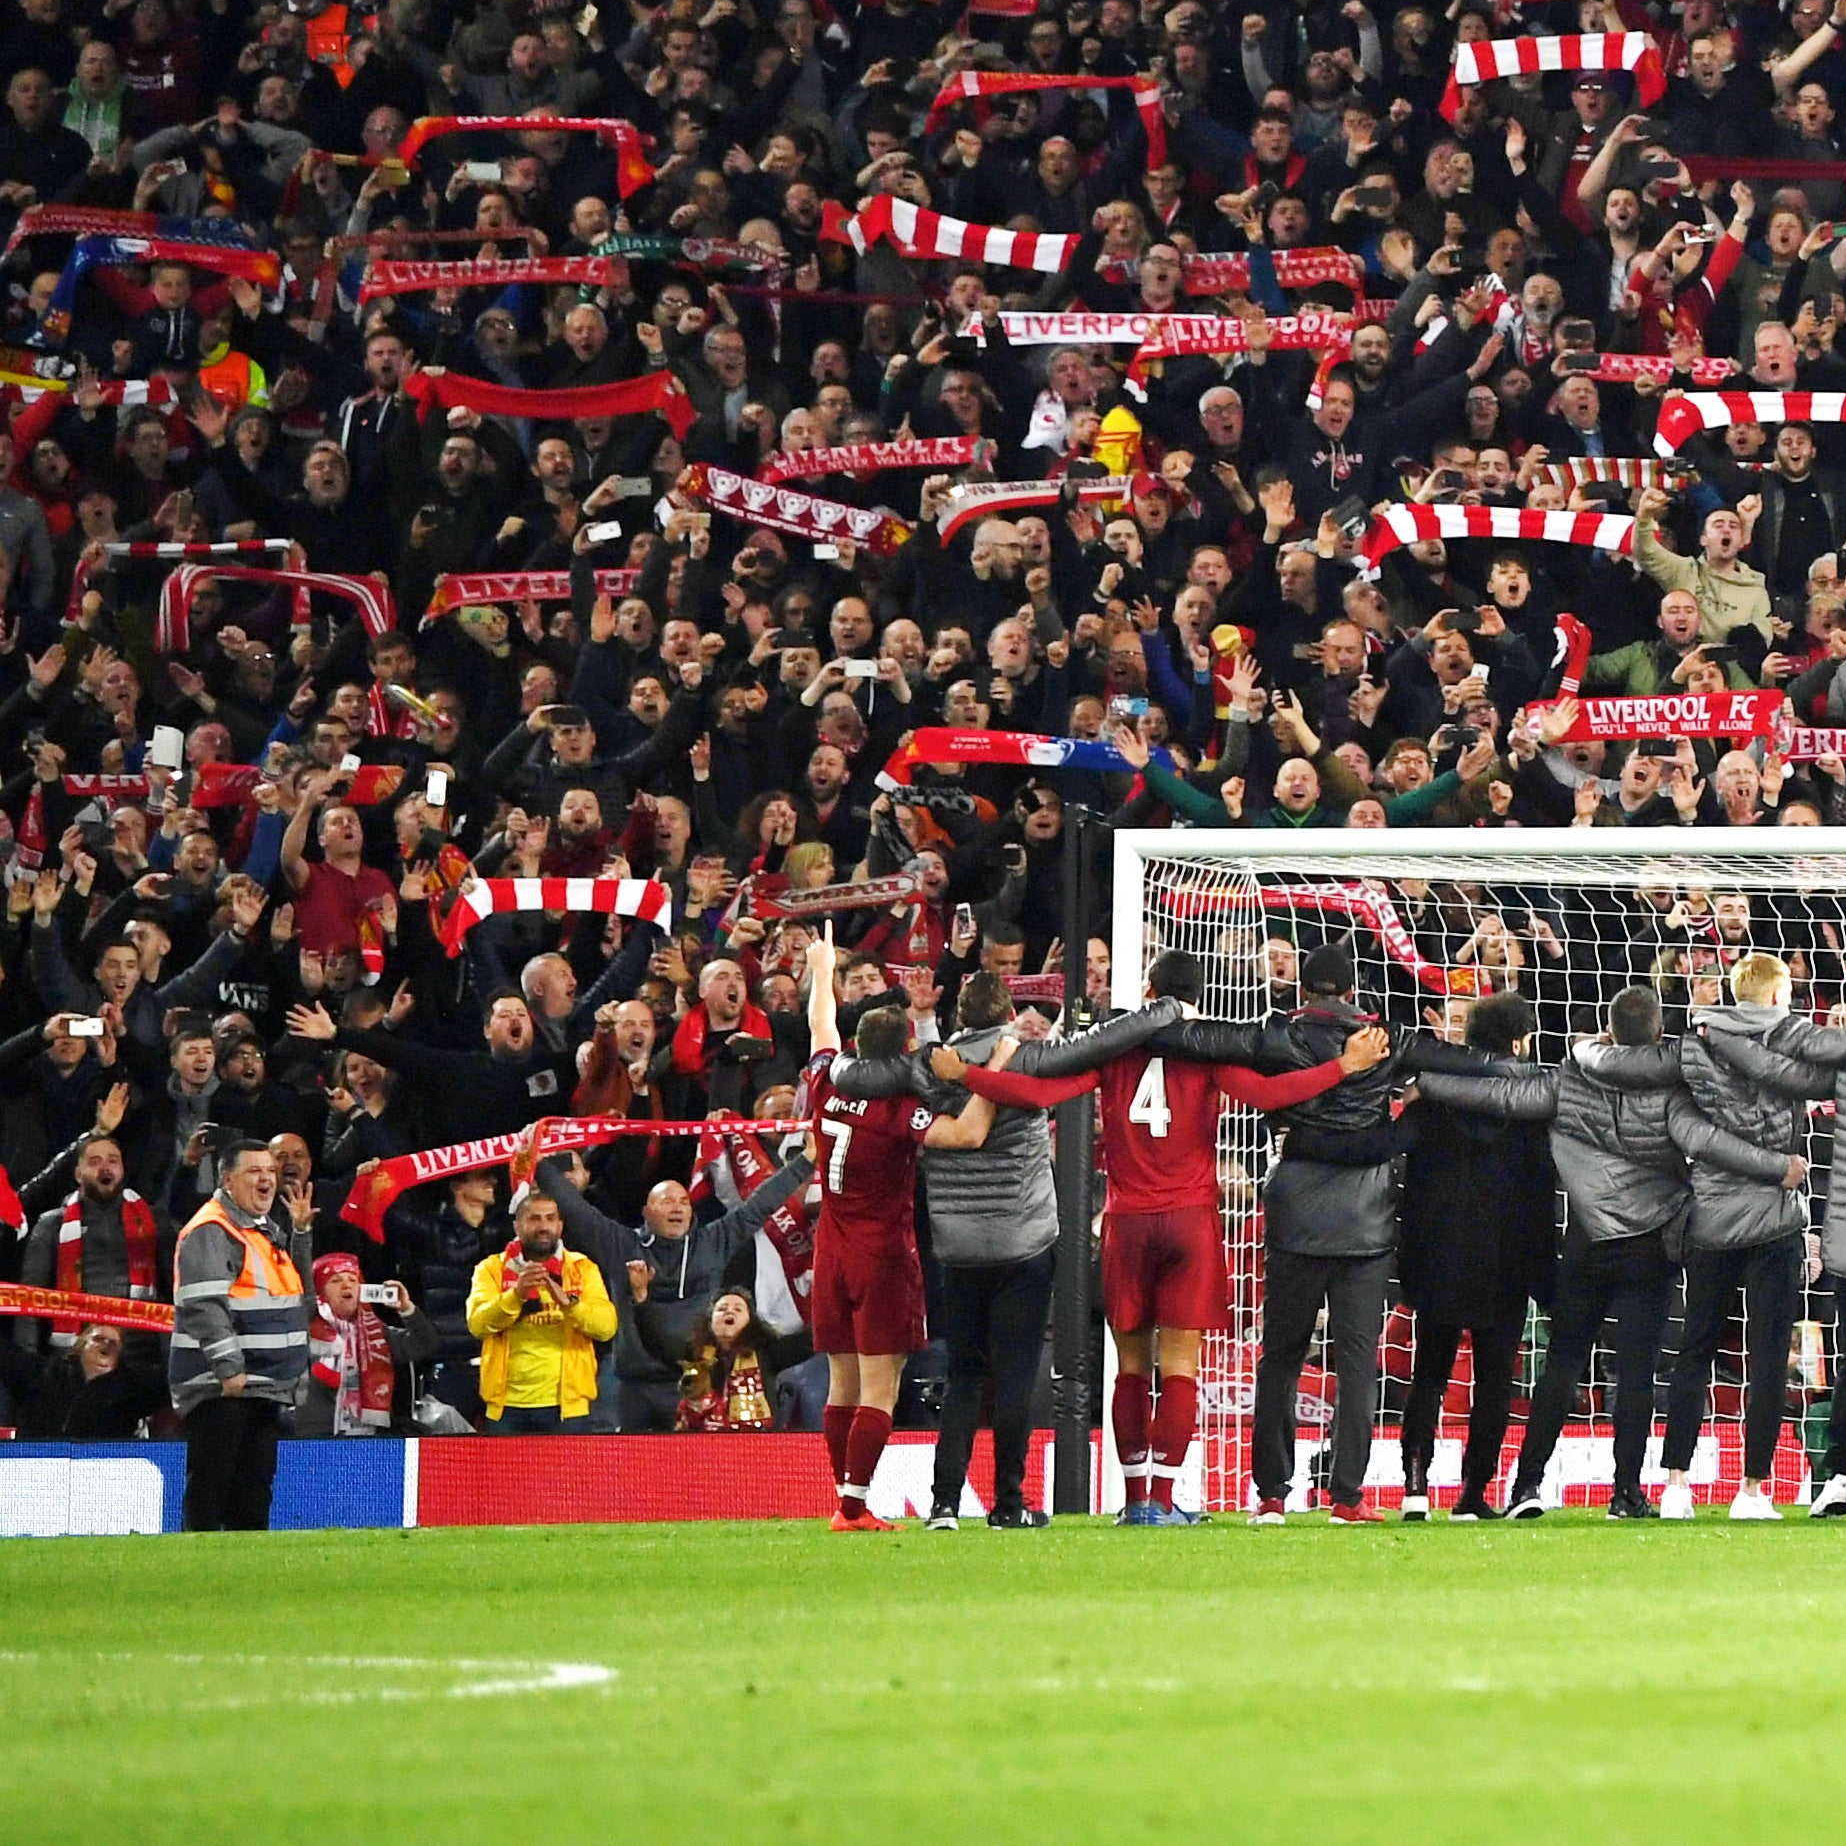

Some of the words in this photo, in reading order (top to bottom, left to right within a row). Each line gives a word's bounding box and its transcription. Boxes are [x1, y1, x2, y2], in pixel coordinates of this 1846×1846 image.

[389, 258, 547, 284] LIVERPOOL
[918, 452, 960, 465] ALONE
[1585, 695, 1711, 725] LIVERPOOL
[1729, 694, 1759, 720] FC
[1589, 722, 1628, 735] YOU'LL
[1636, 722, 1672, 734] NEVER
[1679, 720, 1710, 733] WALK
[1717, 720, 1754, 732] ALONE
[219, 981, 270, 1013] VANS
[1128, 1056, 1172, 1138] 4
[820, 1117, 852, 1194] 7
